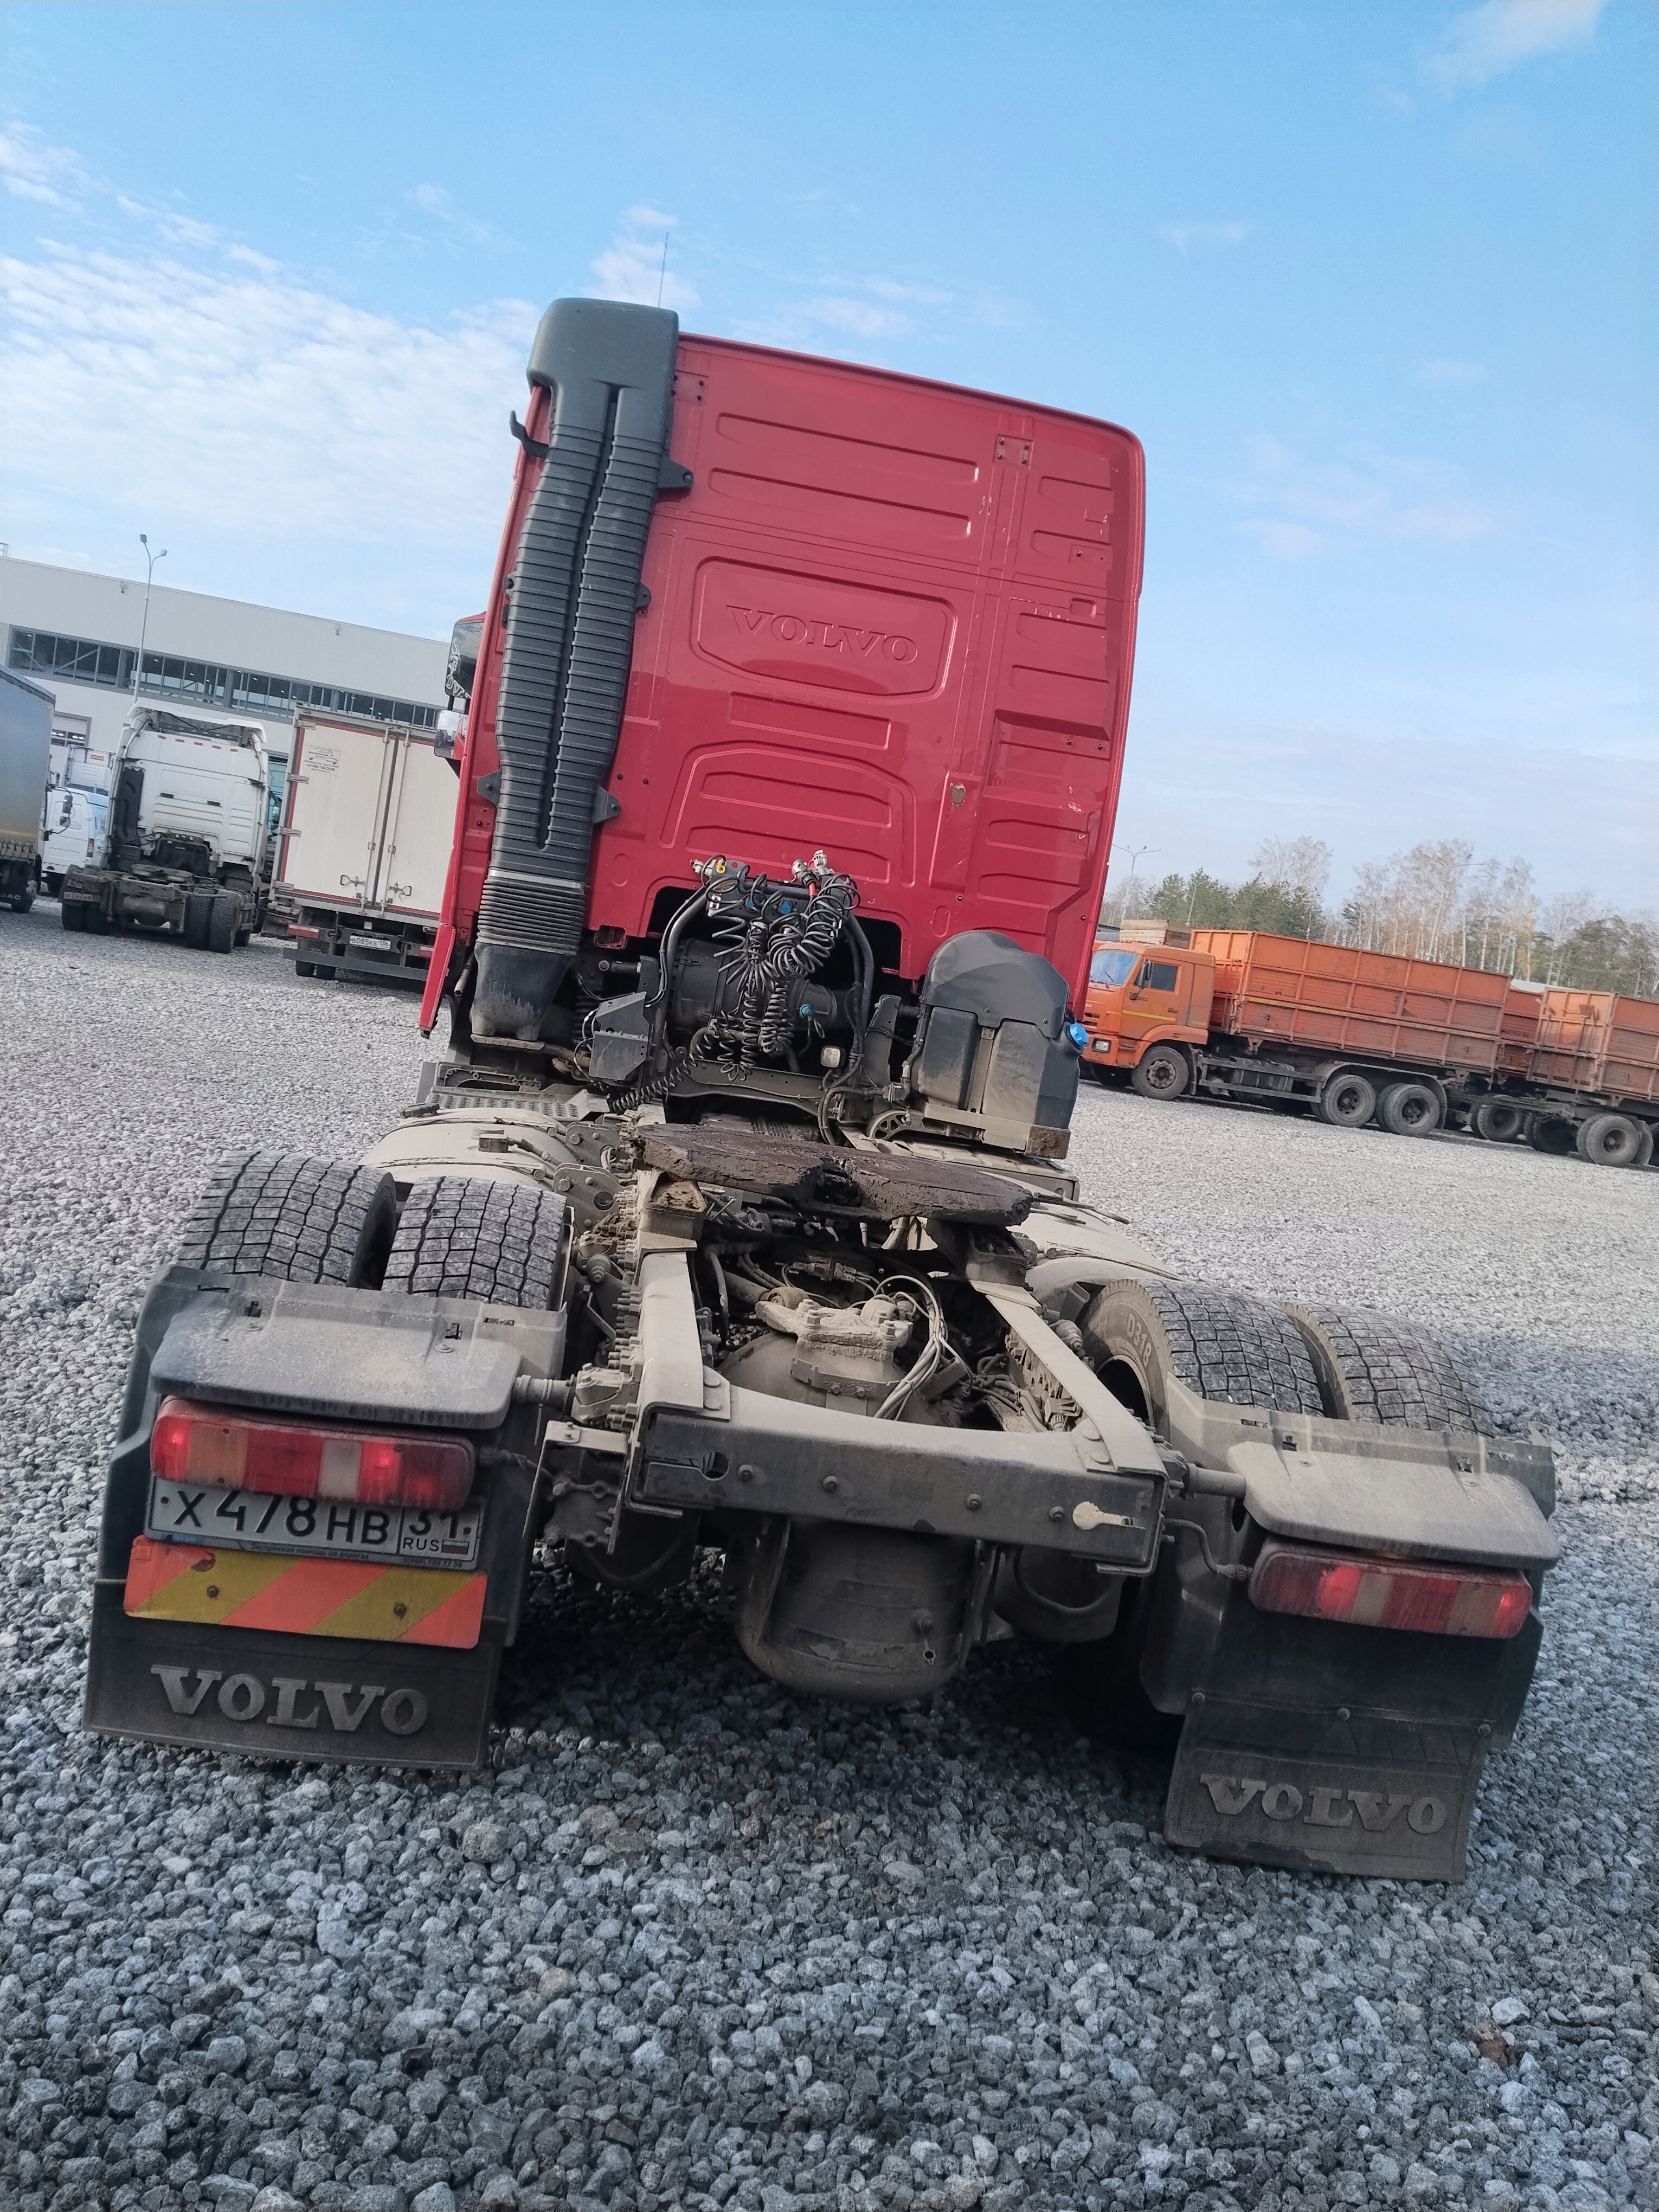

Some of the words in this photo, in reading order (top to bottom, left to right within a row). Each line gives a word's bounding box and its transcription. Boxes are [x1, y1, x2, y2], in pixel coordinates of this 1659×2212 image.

[725, 605, 918, 665] VOLVO
[1126, 1313, 1152, 1368] D318
[250, 1543, 294, 1554] Экстренная
[402, 1537, 440, 1552] RUS
[409, 1510, 458, 1539] 31
[150, 1665, 428, 1735] VOLVO
[1200, 1773, 1447, 1834] VOLVO
